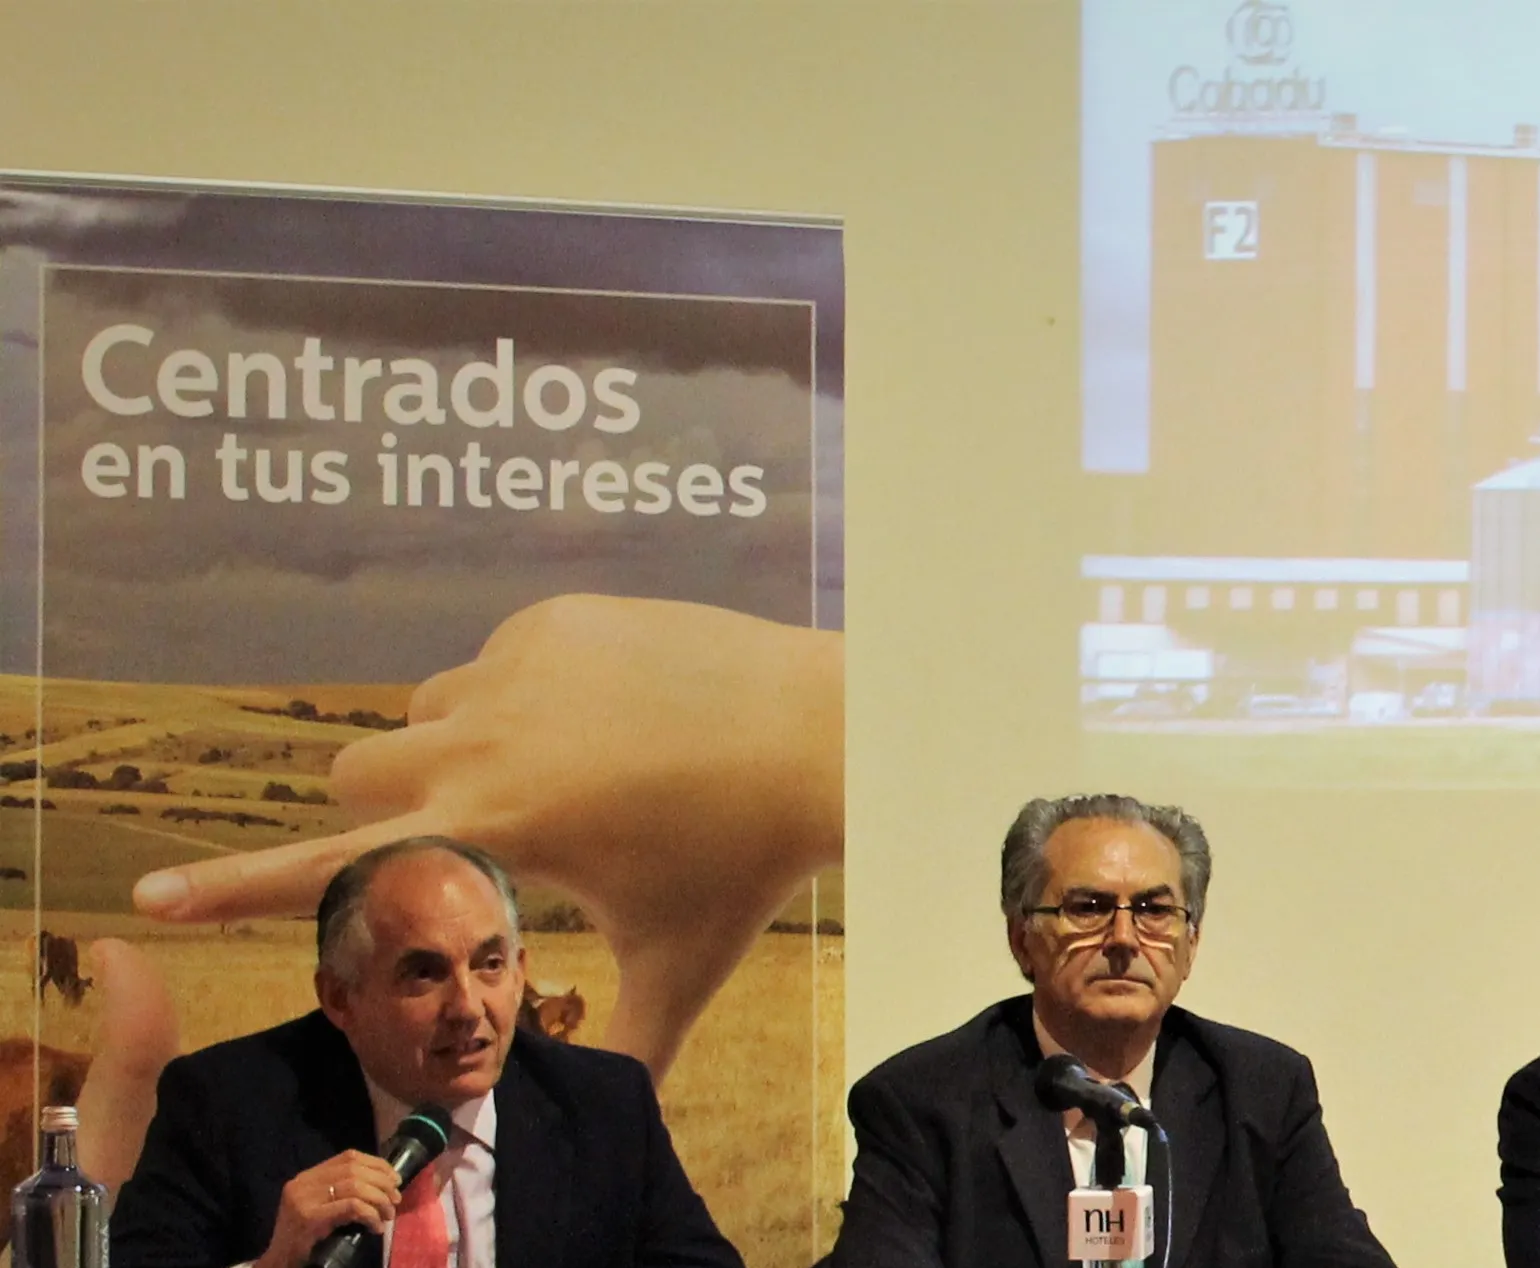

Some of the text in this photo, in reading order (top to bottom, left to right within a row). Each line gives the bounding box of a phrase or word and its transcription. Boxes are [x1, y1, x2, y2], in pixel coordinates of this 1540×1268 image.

[1168, 64, 1326, 112] Cobadu
[1208, 206, 1257, 253] F2
[81, 324, 641, 433] Centrados
[81, 433, 767, 518] en tus intereses
